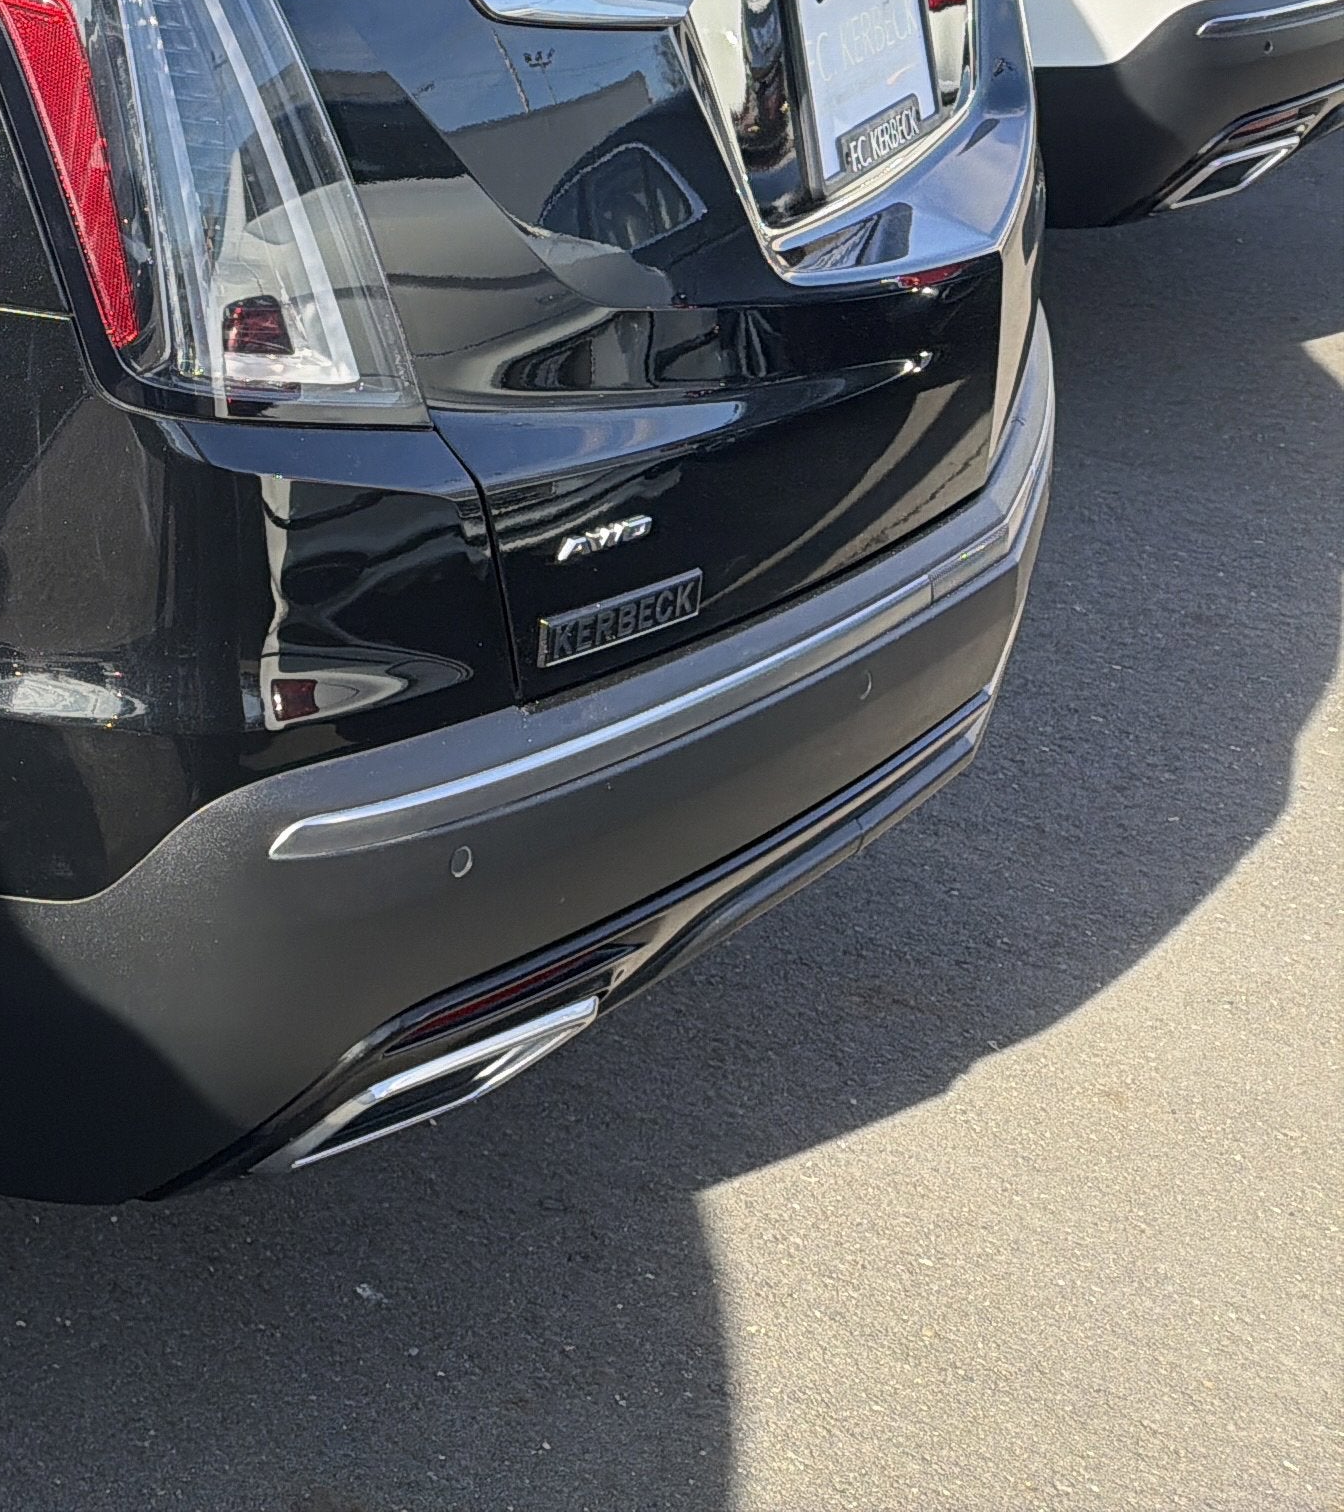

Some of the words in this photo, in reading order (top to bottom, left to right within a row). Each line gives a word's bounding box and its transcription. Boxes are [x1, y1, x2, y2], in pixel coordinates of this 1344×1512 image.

[849, 135, 872, 172] F.C.
[870, 108, 920, 162] KERBECK
[552, 581, 696, 659] KERBECK
